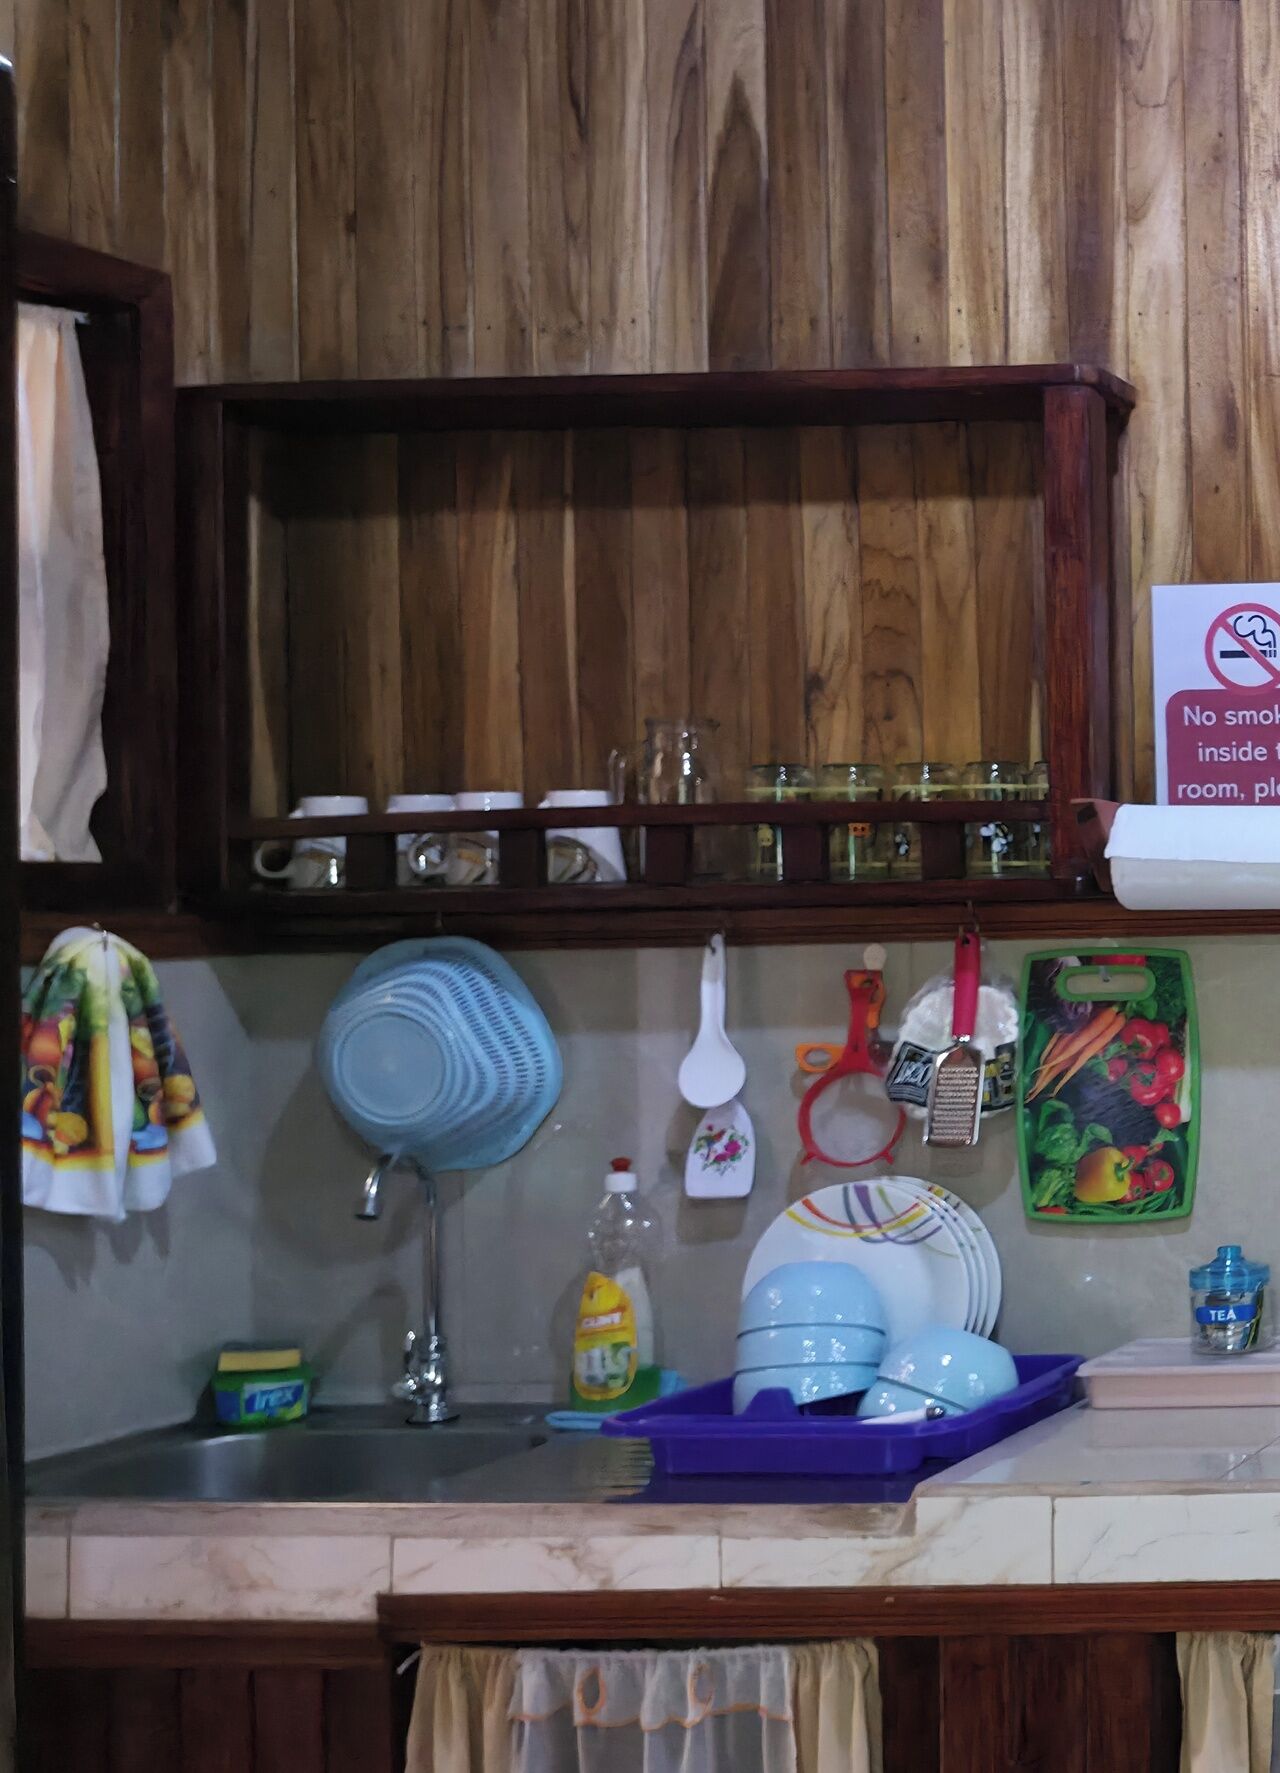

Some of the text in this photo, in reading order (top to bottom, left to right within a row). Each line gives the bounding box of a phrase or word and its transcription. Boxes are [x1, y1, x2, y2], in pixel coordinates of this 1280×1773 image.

[1183, 705, 1217, 727] No
[1198, 740, 1268, 762] inside
[1177, 782, 1246, 801] room,
[1209, 1308, 1237, 1321] TEA
